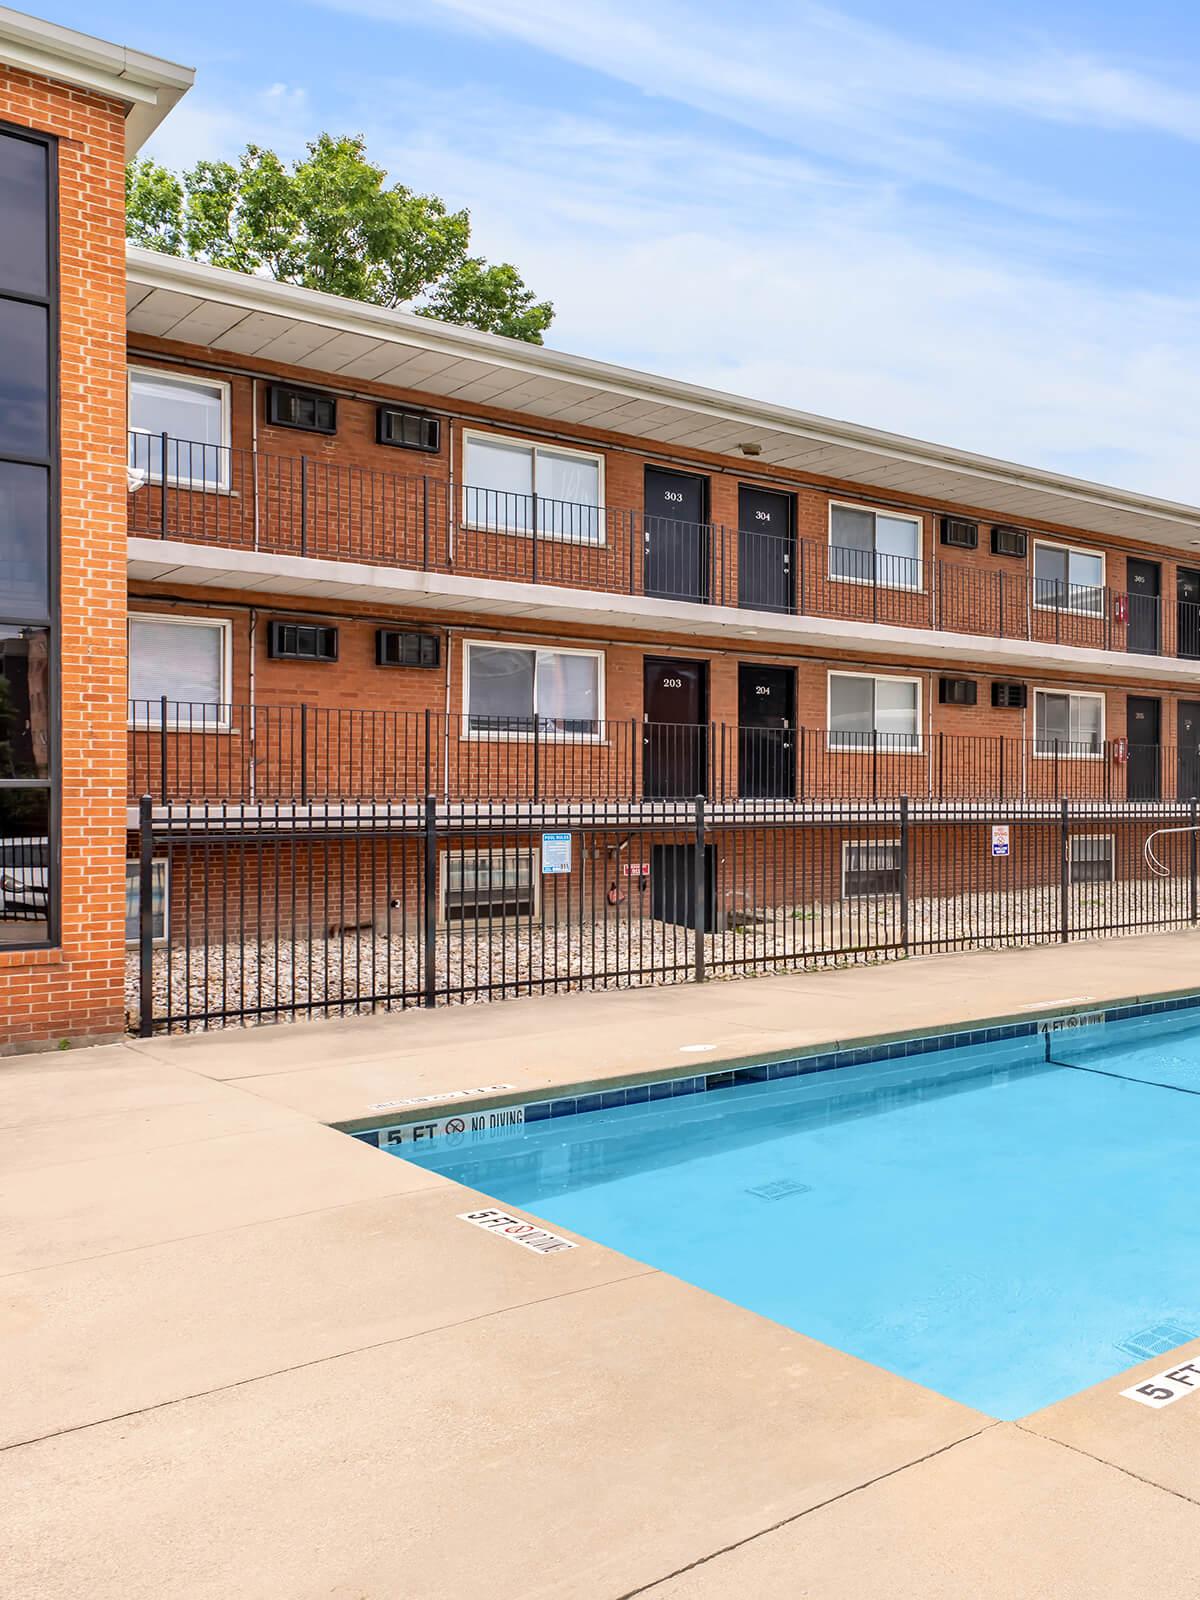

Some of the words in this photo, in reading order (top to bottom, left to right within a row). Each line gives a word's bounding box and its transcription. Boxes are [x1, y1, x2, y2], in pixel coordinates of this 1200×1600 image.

[664, 491, 683, 502] 303
[755, 511, 771, 521] 304
[663, 679, 682, 688] 203
[755, 686, 770, 695] 204
[1053, 1020, 1065, 1031] FT
[387, 1129, 402, 1146] 5
[413, 1123, 438, 1142] FT
[472, 1115, 486, 1132] NO
[490, 1109, 523, 1129] DIVING
[467, 1211, 498, 1219] 5
[479, 1217, 518, 1228] FT
[1136, 1383, 1175, 1400] 5
